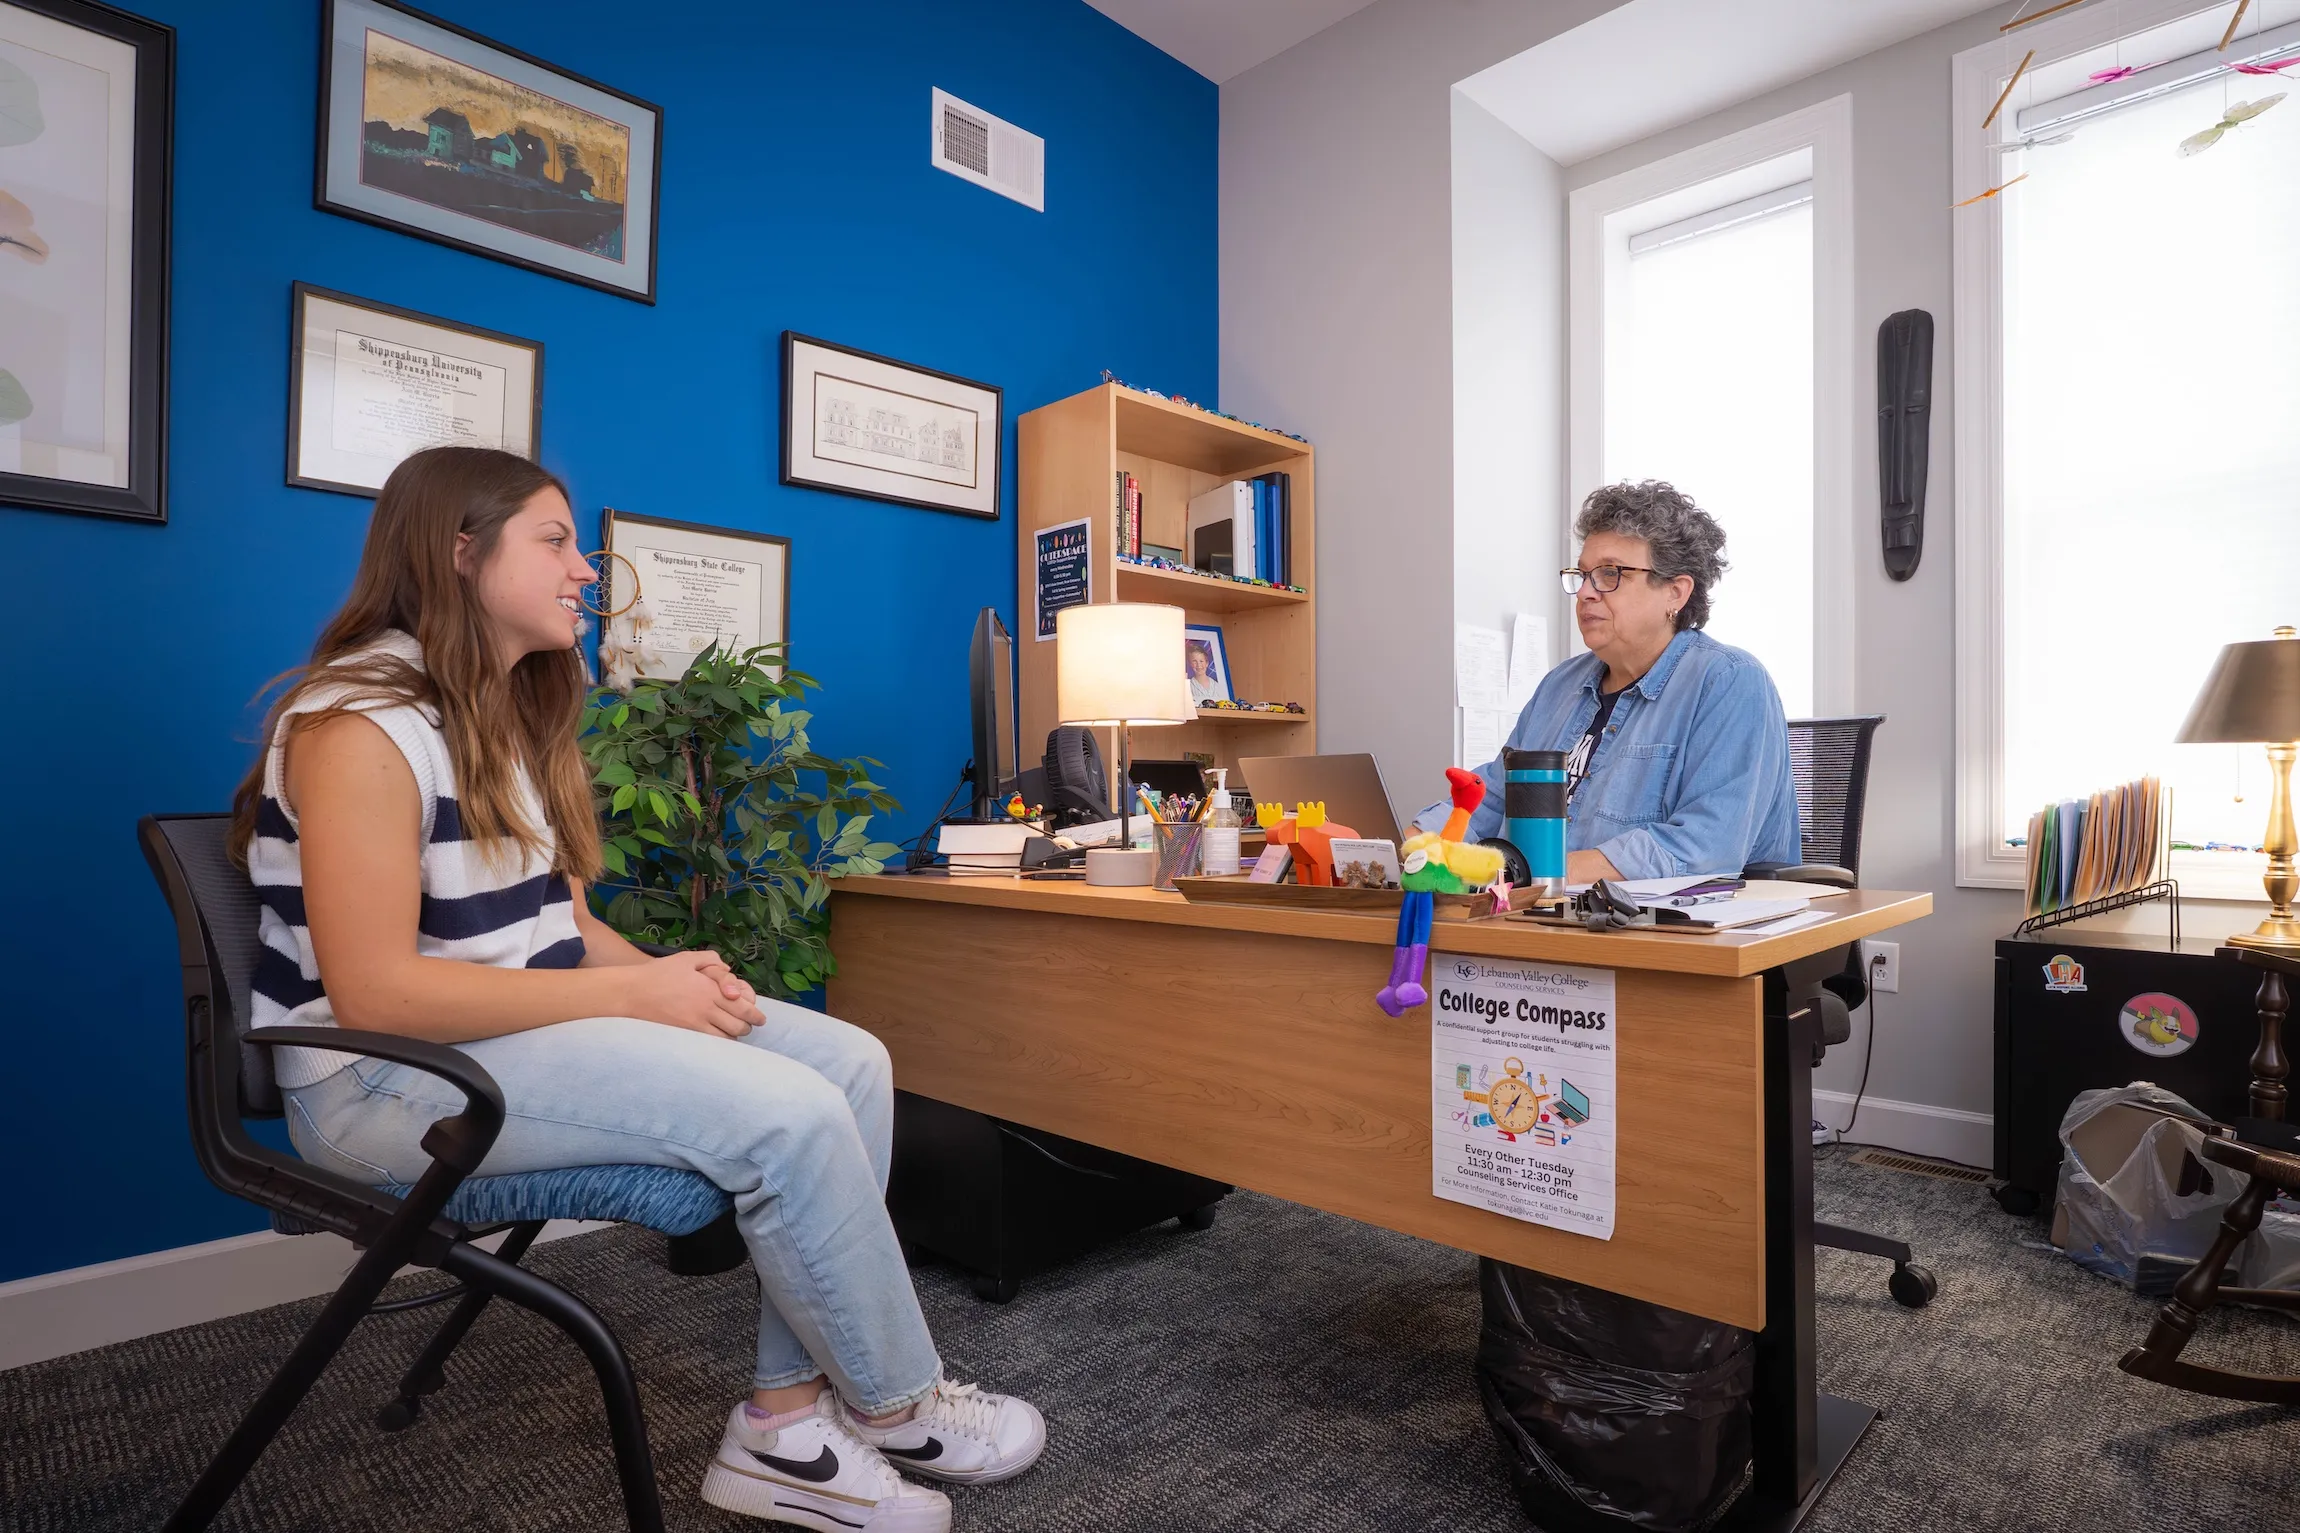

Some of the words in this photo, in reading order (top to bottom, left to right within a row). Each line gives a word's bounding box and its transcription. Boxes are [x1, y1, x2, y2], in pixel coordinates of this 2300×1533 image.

[358, 338, 428, 366] Shippensburg
[432, 355, 482, 380] University
[396, 360, 460, 382] Pennsylvania
[653, 552, 698, 568] Shippensburg
[701, 558, 718, 569] State
[721, 562, 745, 574] College
[1457, 964, 1476, 978] LVC
[1481, 966, 1520, 980] Lebanon
[1521, 970, 1550, 985] Valley
[1552, 973, 1589, 989] College
[2044, 964, 2080, 983] LHA
[1495, 981, 1535, 992] COUNSELING
[1535, 986, 1565, 995] SERVICES
[1440, 988, 1510, 1024] College
[1516, 998, 1606, 1033] Compass
[1442, 1021, 1476, 1032] confidential
[1476, 1027, 1500, 1037] support
[1501, 1031, 1520, 1039] group
[1520, 1032, 1530, 1040] for
[1531, 1034, 1560, 1044] students
[1561, 1038, 1594, 1050] struggling
[1482, 1037, 1510, 1047] adjusting
[1519, 1042, 1542, 1052] college
[1543, 1045, 1556, 1053] life.
[1465, 1144, 1493, 1160] Every
[1495, 1151, 1526, 1165] Other
[1528, 1157, 1574, 1178] Tuesday
[1467, 1156, 1494, 1170] 11:30
[1496, 1165, 1512, 1175] am
[1521, 1169, 1551, 1183] 12:30
[1554, 1177, 1572, 1188] pm
[1457, 1166, 1505, 1186] Counseling
[1507, 1178, 1546, 1194] Services
[1548, 1187, 1578, 1201] Office
[1441, 1177, 1452, 1185] For
[1452, 1180, 1470, 1190] More
[1470, 1184, 1510, 1200] Information,
[1511, 1195, 1538, 1207] Contact
[1540, 1201, 1558, 1212] Katie
[1559, 1206, 1595, 1222] Tokunaga
[1487, 1199, 1549, 1221] tokunaga@lvc.edu
